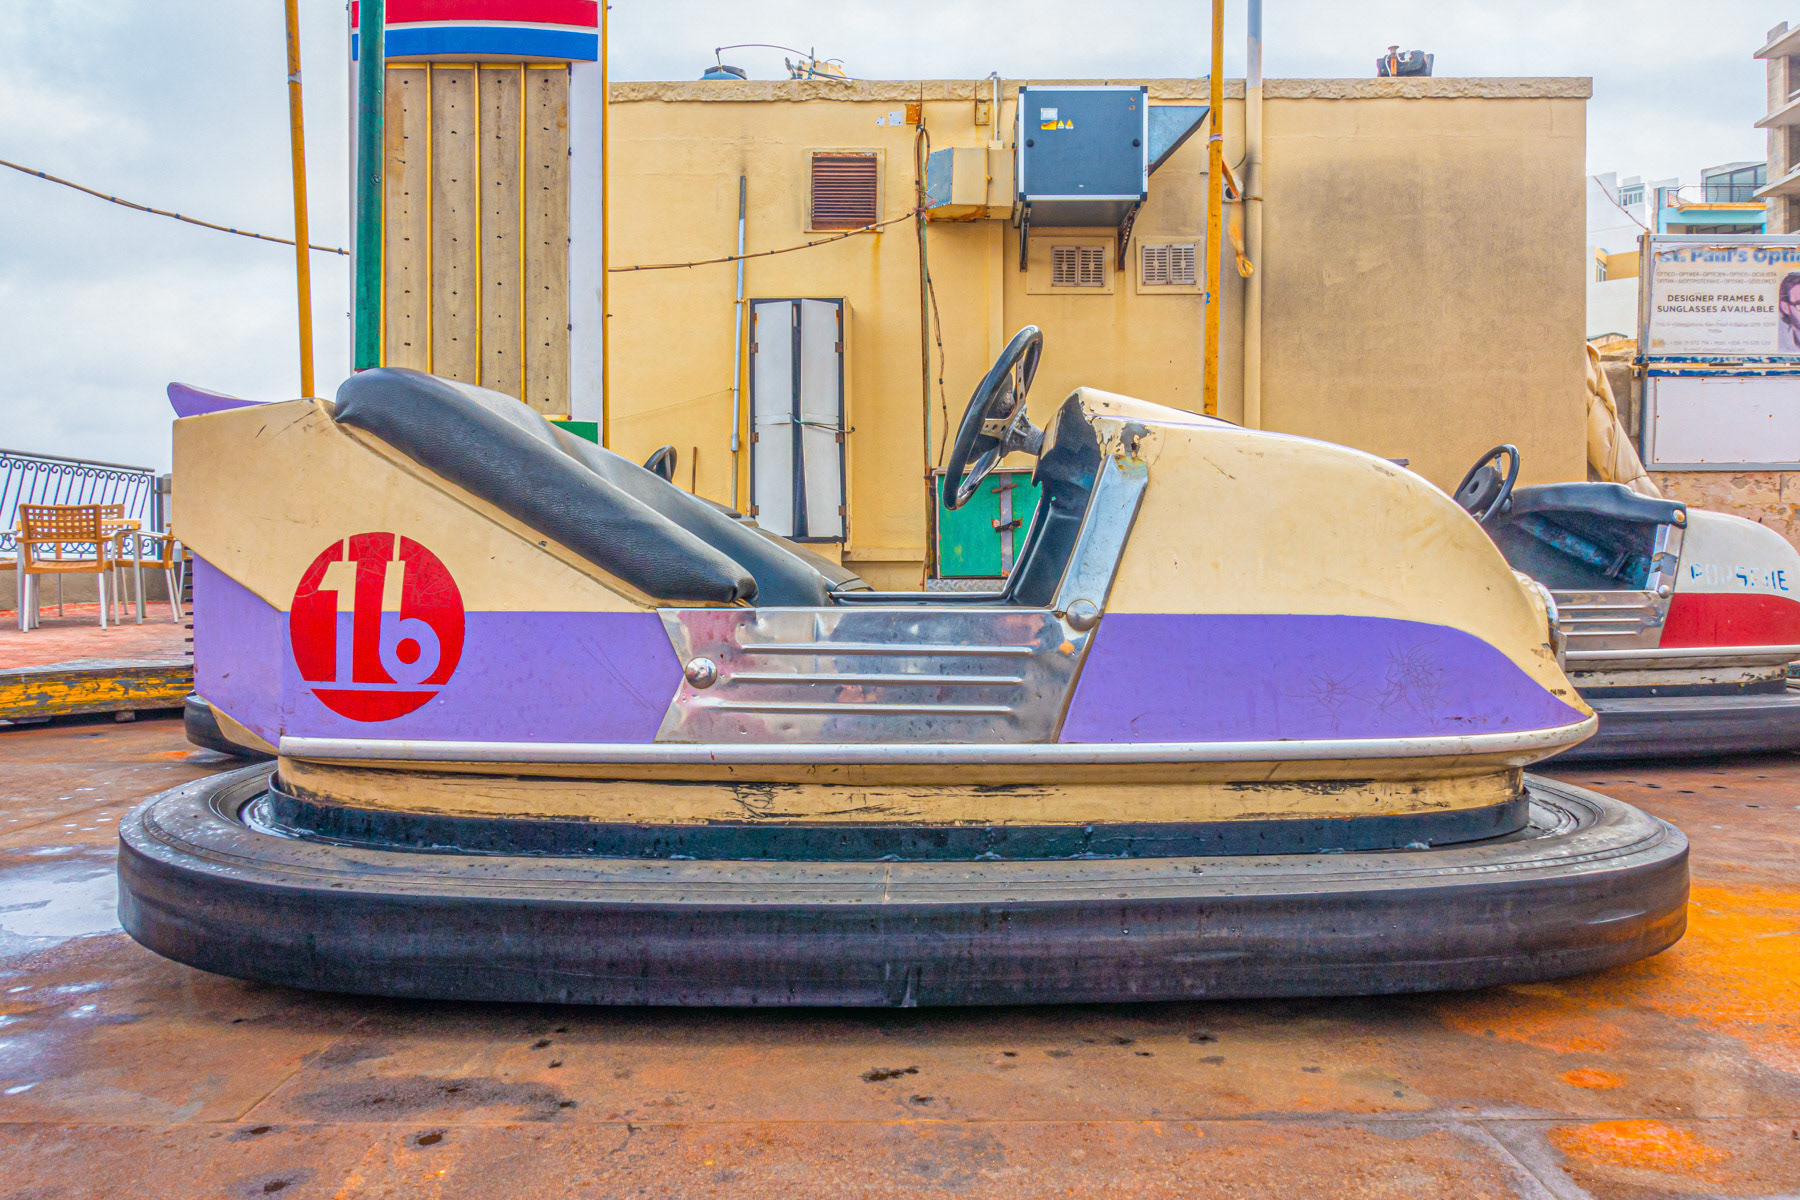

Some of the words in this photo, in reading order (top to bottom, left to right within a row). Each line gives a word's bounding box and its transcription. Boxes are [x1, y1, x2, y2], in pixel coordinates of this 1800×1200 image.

[1659, 250, 1686, 263] St.
[1691, 248, 1748, 263] Paul's
[1667, 294, 1715, 302] DESIGNER
[1717, 294, 1755, 302] FRAMES
[1757, 294, 1764, 302] &
[1656, 305, 1718, 313] SUNGLASSES
[1720, 305, 1775, 313] AVAILABLE
